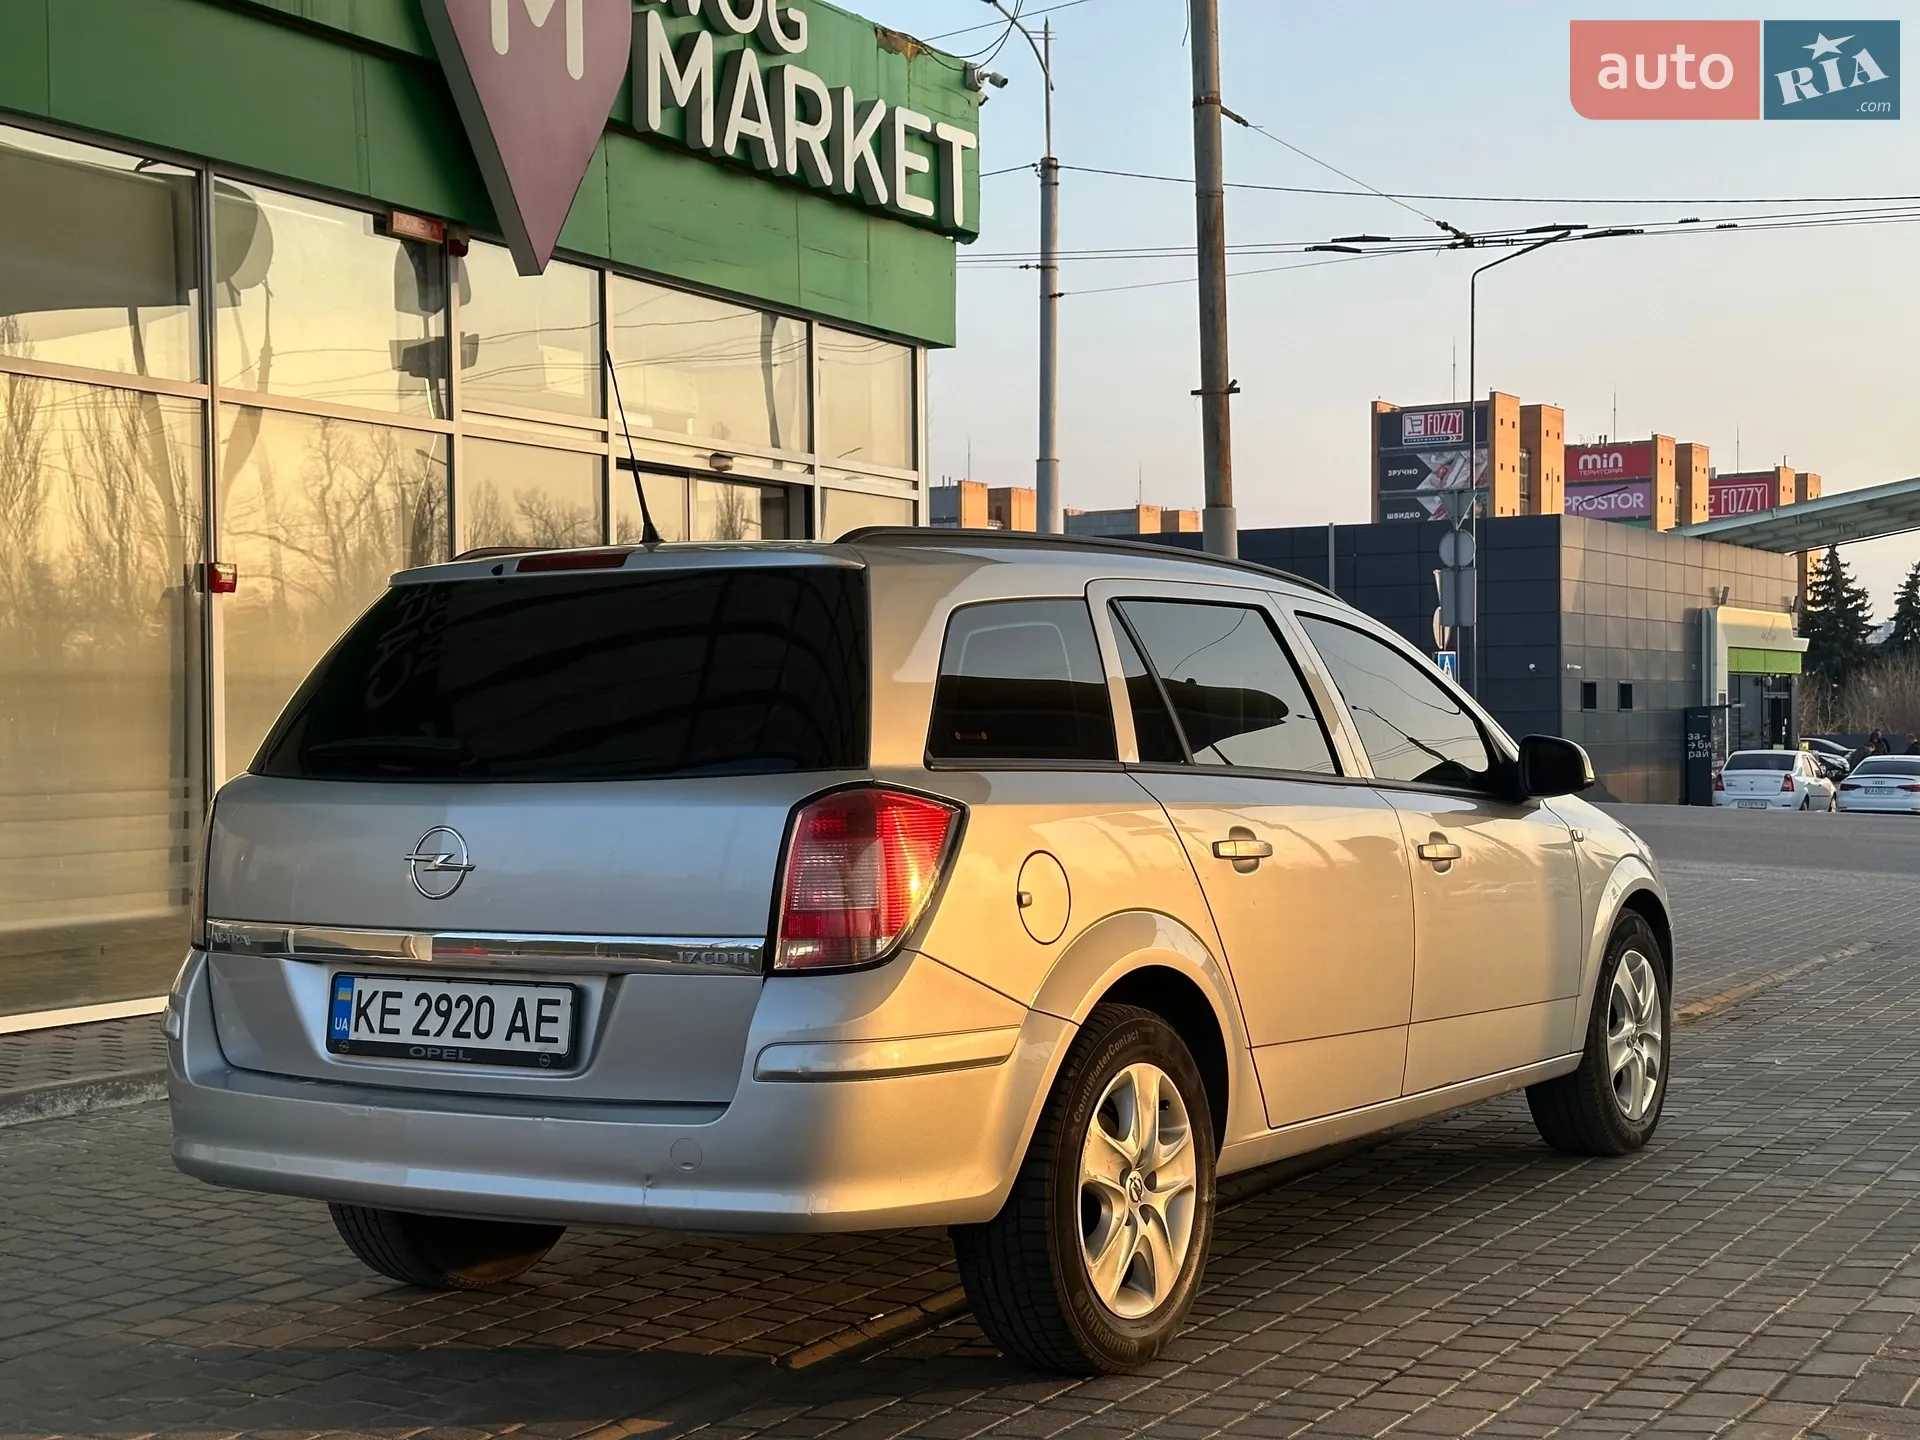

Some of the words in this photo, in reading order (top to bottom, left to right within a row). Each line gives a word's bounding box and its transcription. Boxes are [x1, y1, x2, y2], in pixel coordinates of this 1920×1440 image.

[646, 10, 977, 227] MARKET
[1427, 412, 1461, 435] FOZZY
[1387, 468, 1419, 477] ЗРУЧНО
[1564, 492, 1644, 512] PROSTOR
[1721, 486, 1764, 514] FOZZY
[1386, 511, 1421, 520] ШВИДКО
[1688, 749, 1709, 760] рай
[700, 951, 750, 965] CDTI
[334, 1016, 349, 1031] UA
[353, 989, 404, 1035] KE
[411, 992, 496, 1040] 2920
[504, 997, 562, 1044] AE
[408, 1045, 472, 1062] OPEL
[1073, 1028, 1140, 1123] ContiWinterContact
